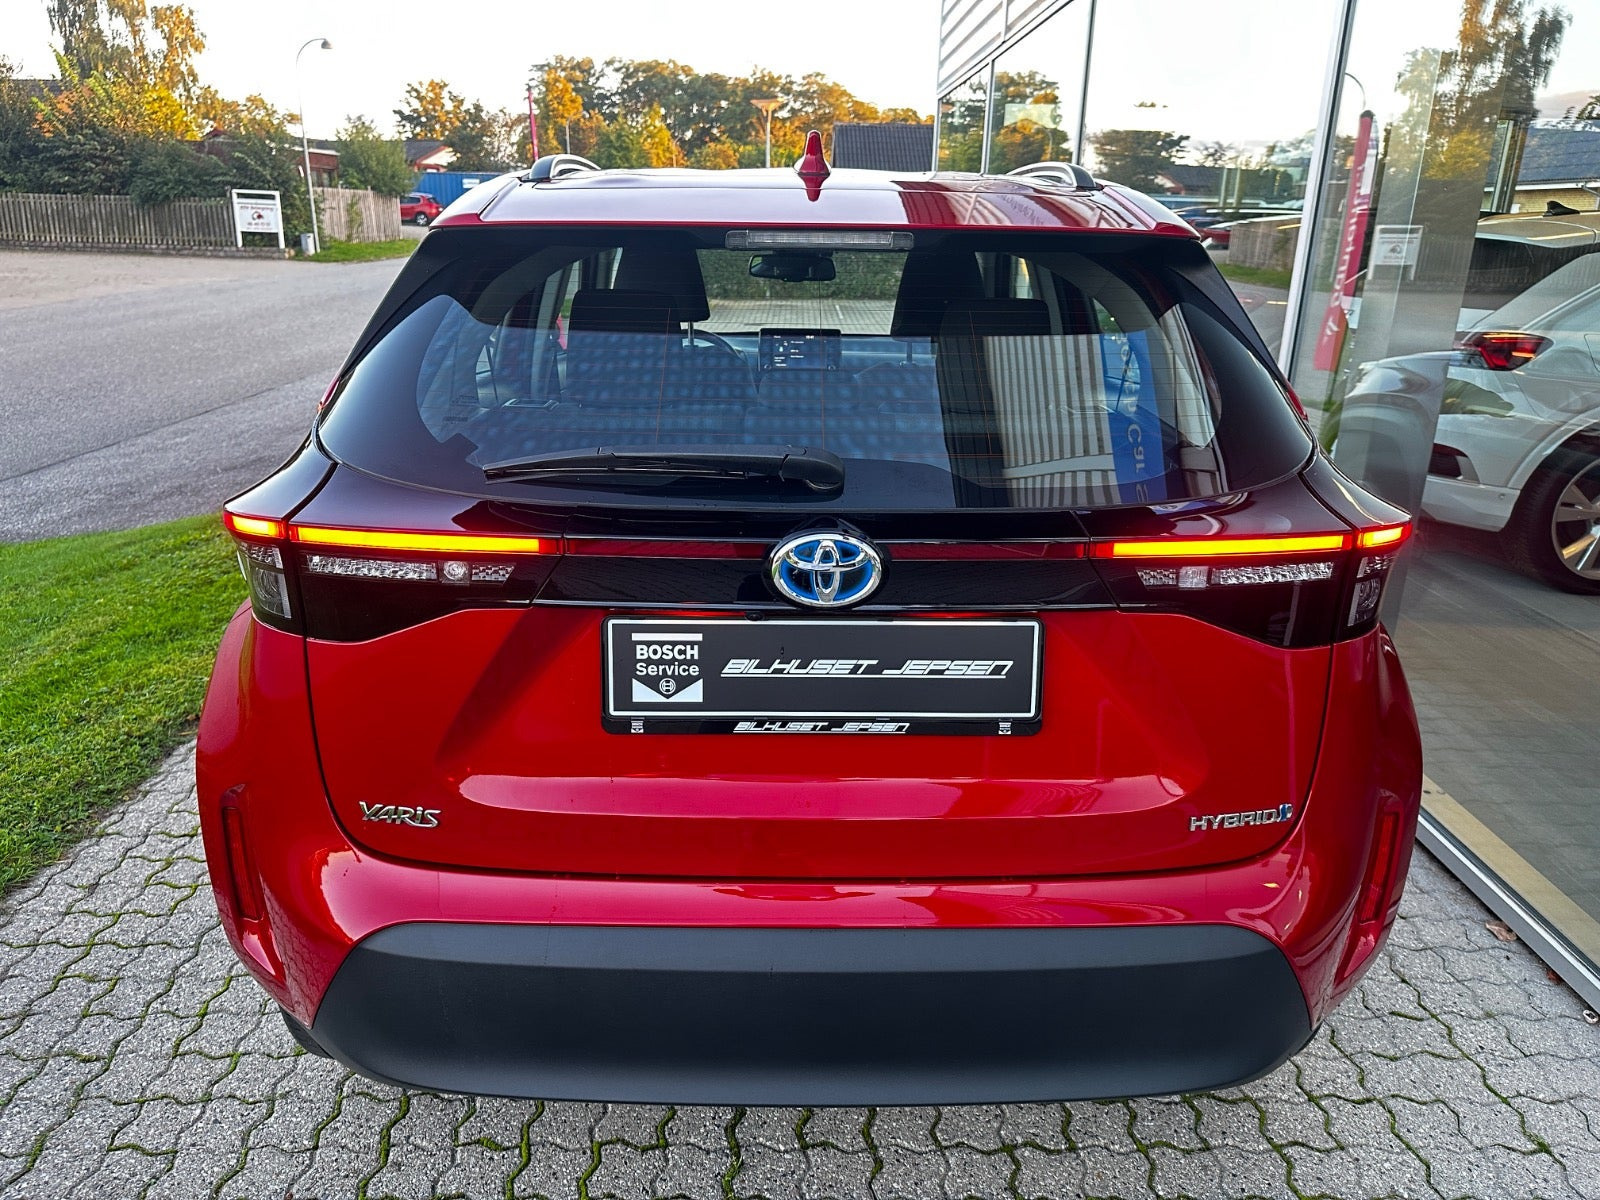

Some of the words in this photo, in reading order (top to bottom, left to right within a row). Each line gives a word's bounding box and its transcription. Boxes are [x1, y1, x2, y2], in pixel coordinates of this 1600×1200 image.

[635, 644, 699, 660] BOSCH
[635, 661, 700, 676] Service
[721, 658, 879, 675] BILHUSET
[881, 659, 1014, 676] JEPSEN
[733, 721, 829, 732] BILHUSET
[830, 721, 911, 733] JEPSEN
[1190, 809, 1278, 832] HYBRID
